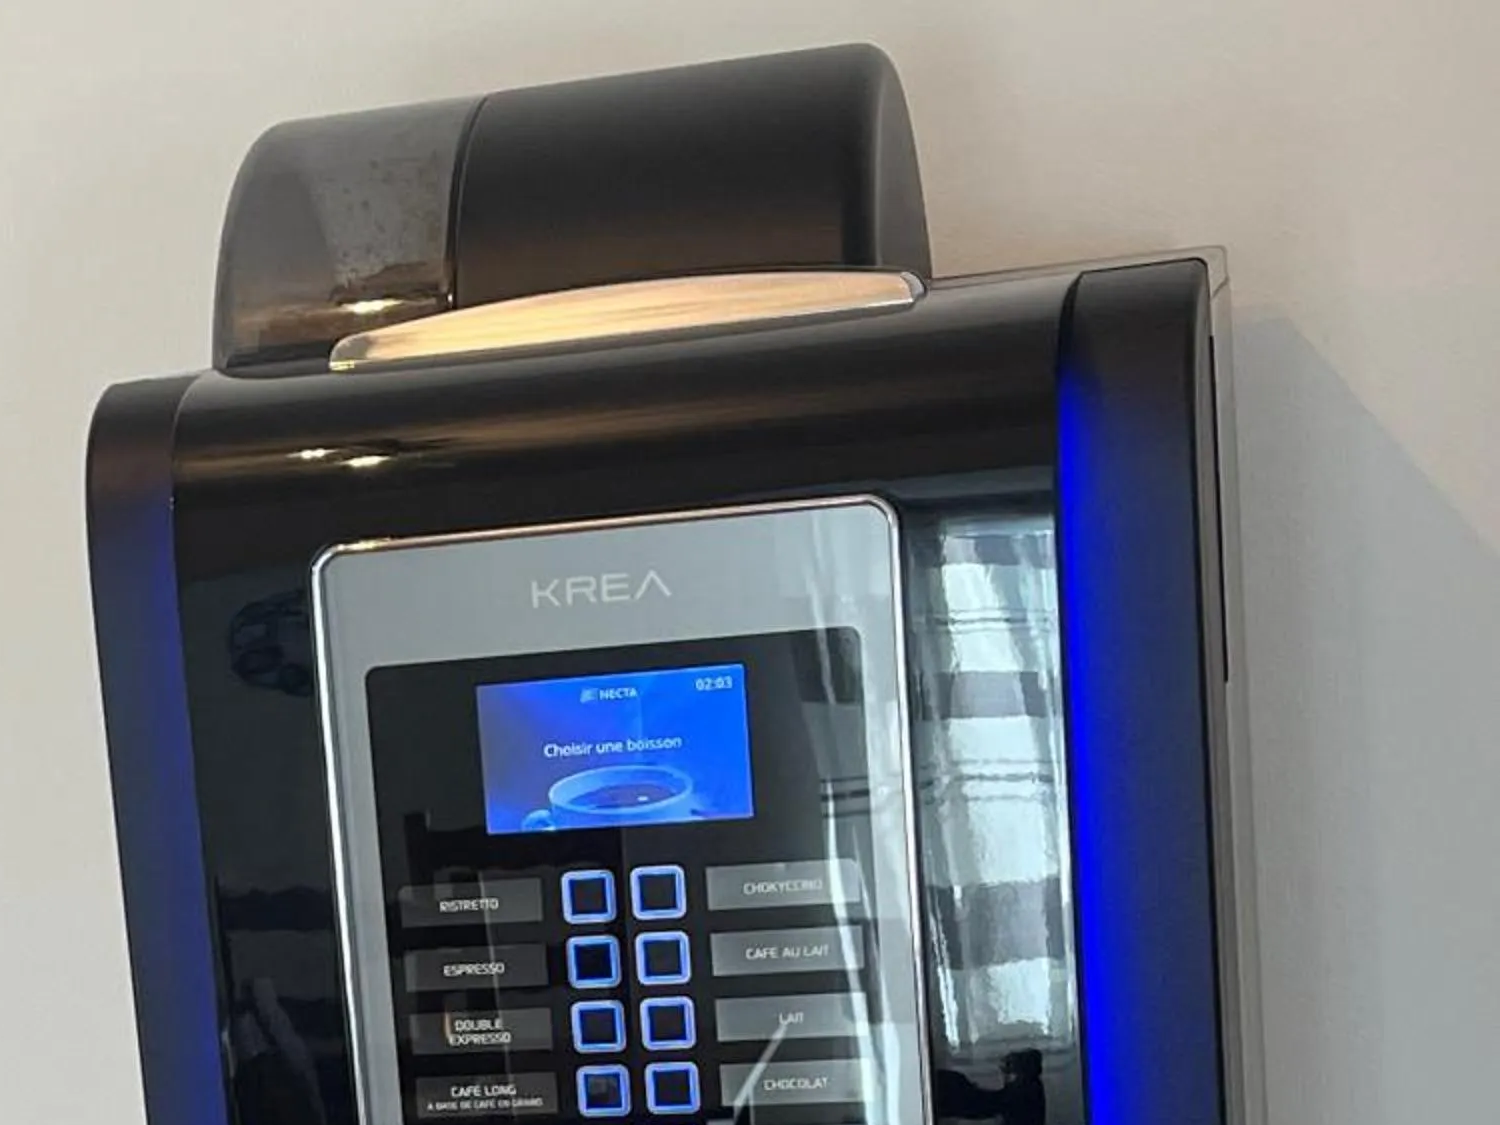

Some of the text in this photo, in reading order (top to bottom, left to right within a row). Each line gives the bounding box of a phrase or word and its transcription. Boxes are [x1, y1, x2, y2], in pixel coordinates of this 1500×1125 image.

[695, 676, 733, 691] 02:03
[599, 687, 638, 701] NECTA
[543, 736, 683, 758] Choisir une boisson
[439, 898, 499, 913] RISTRETTO
[782, 946, 800, 958] AU
[803, 944, 829, 957] LAIT
[443, 962, 505, 976] ESPRESSO
[454, 1018, 502, 1032] DOUBLE
[779, 1012, 804, 1025] LAIT
[483, 1083, 517, 1096] LONG
[763, 1076, 827, 1091] CHOCOLAT
